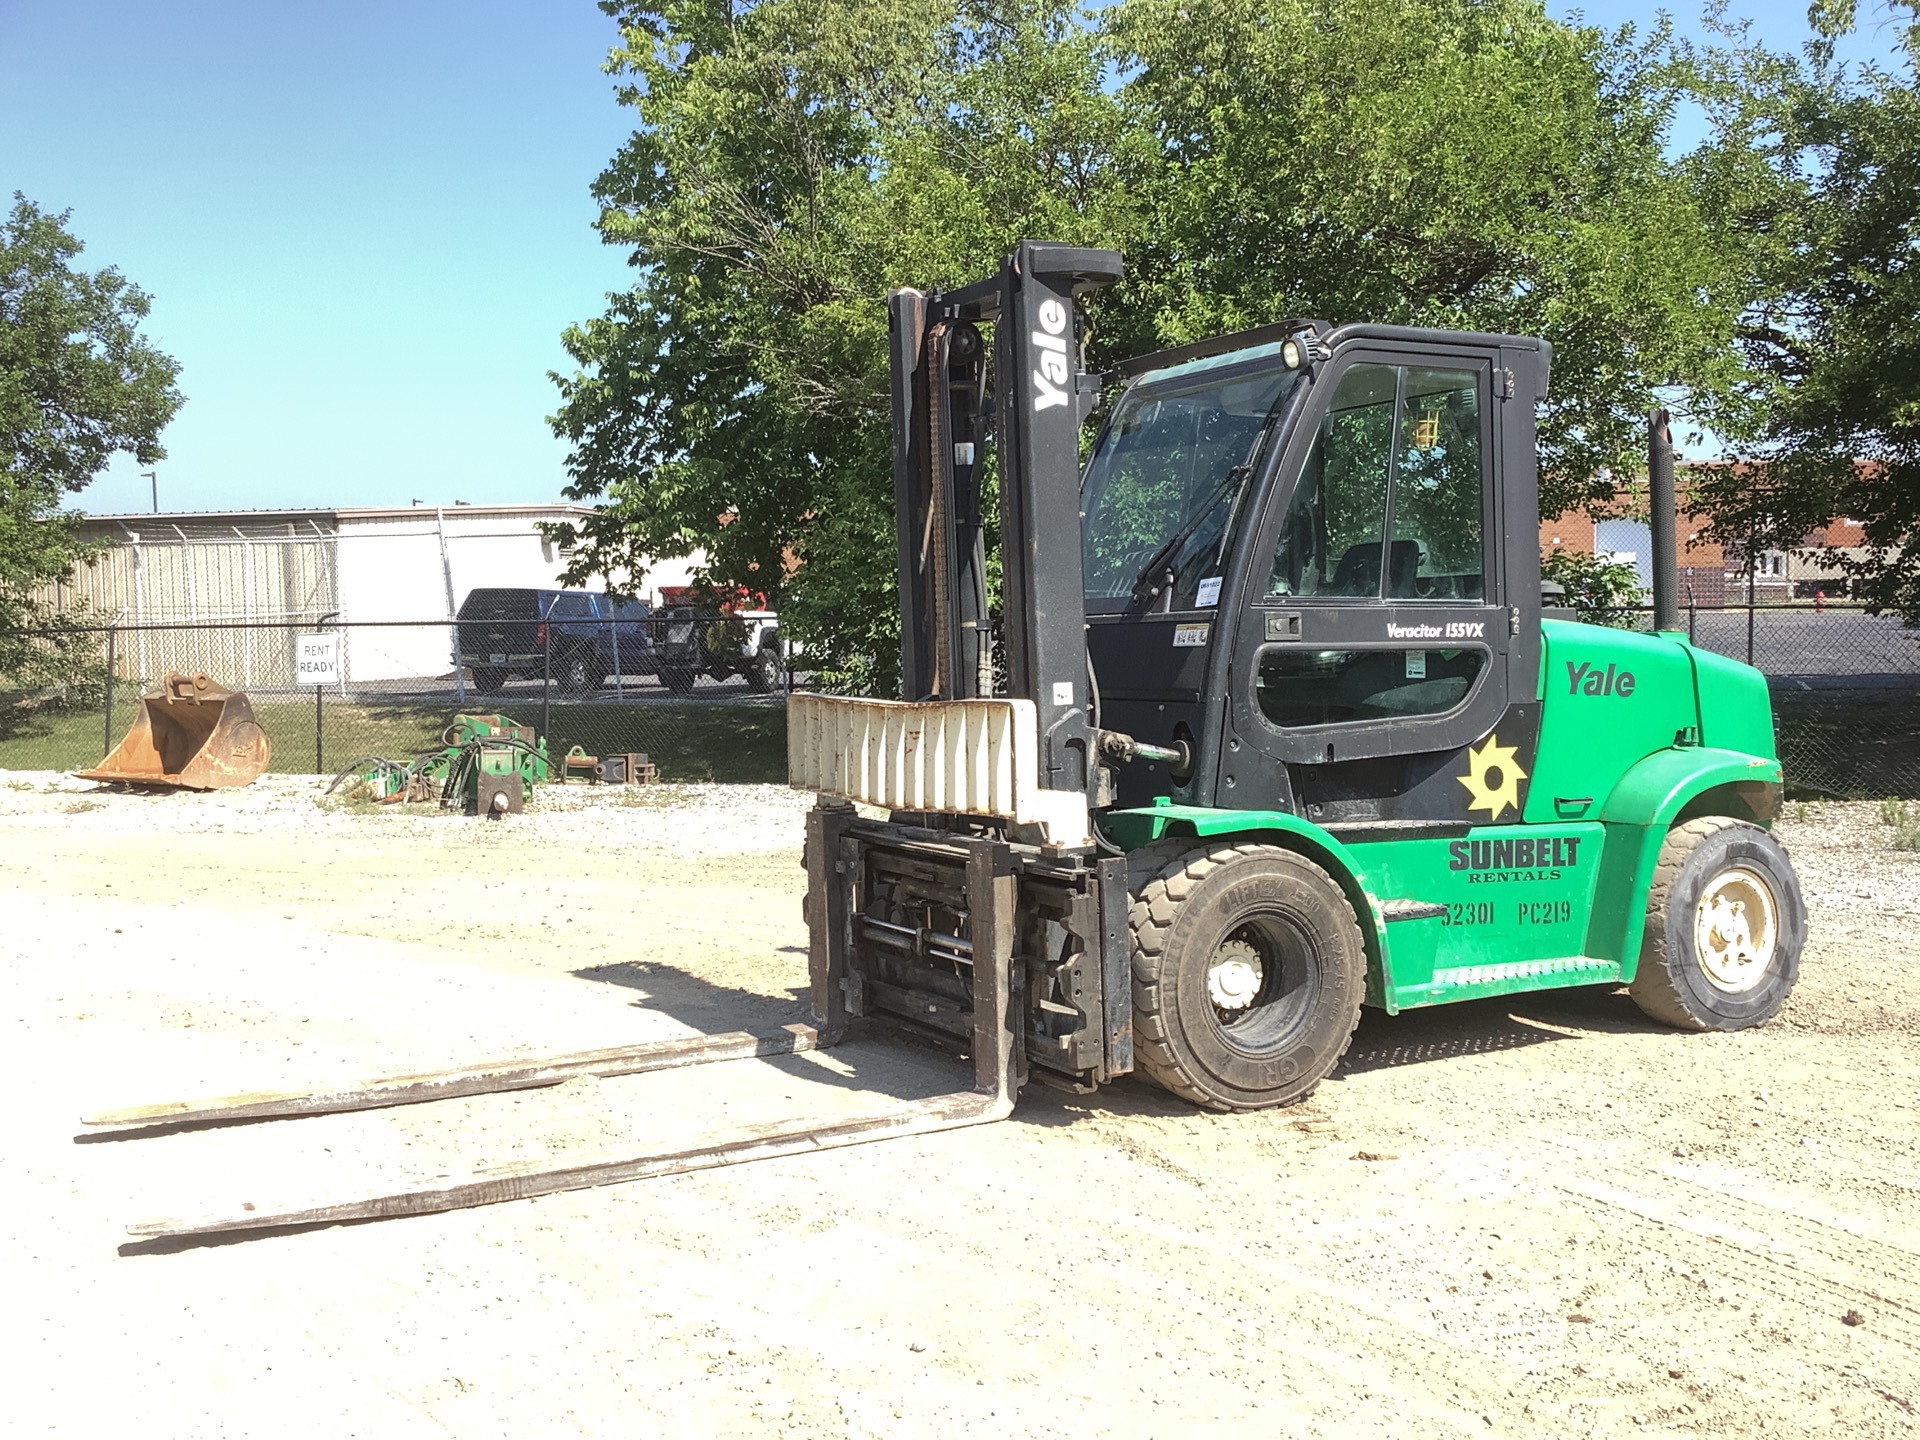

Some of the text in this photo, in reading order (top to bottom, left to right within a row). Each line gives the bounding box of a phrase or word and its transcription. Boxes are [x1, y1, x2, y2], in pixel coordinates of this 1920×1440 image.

[1031, 299, 1069, 412] Yale
[1386, 623, 1443, 638] Veracitor
[304, 645, 330, 656] RENT
[299, 661, 335, 673] READY
[1565, 661, 1636, 697] Yale
[1449, 837, 1580, 871] SUNBELT
[1468, 870, 1562, 884] RENTALS
[1518, 900, 1571, 926] PC219
